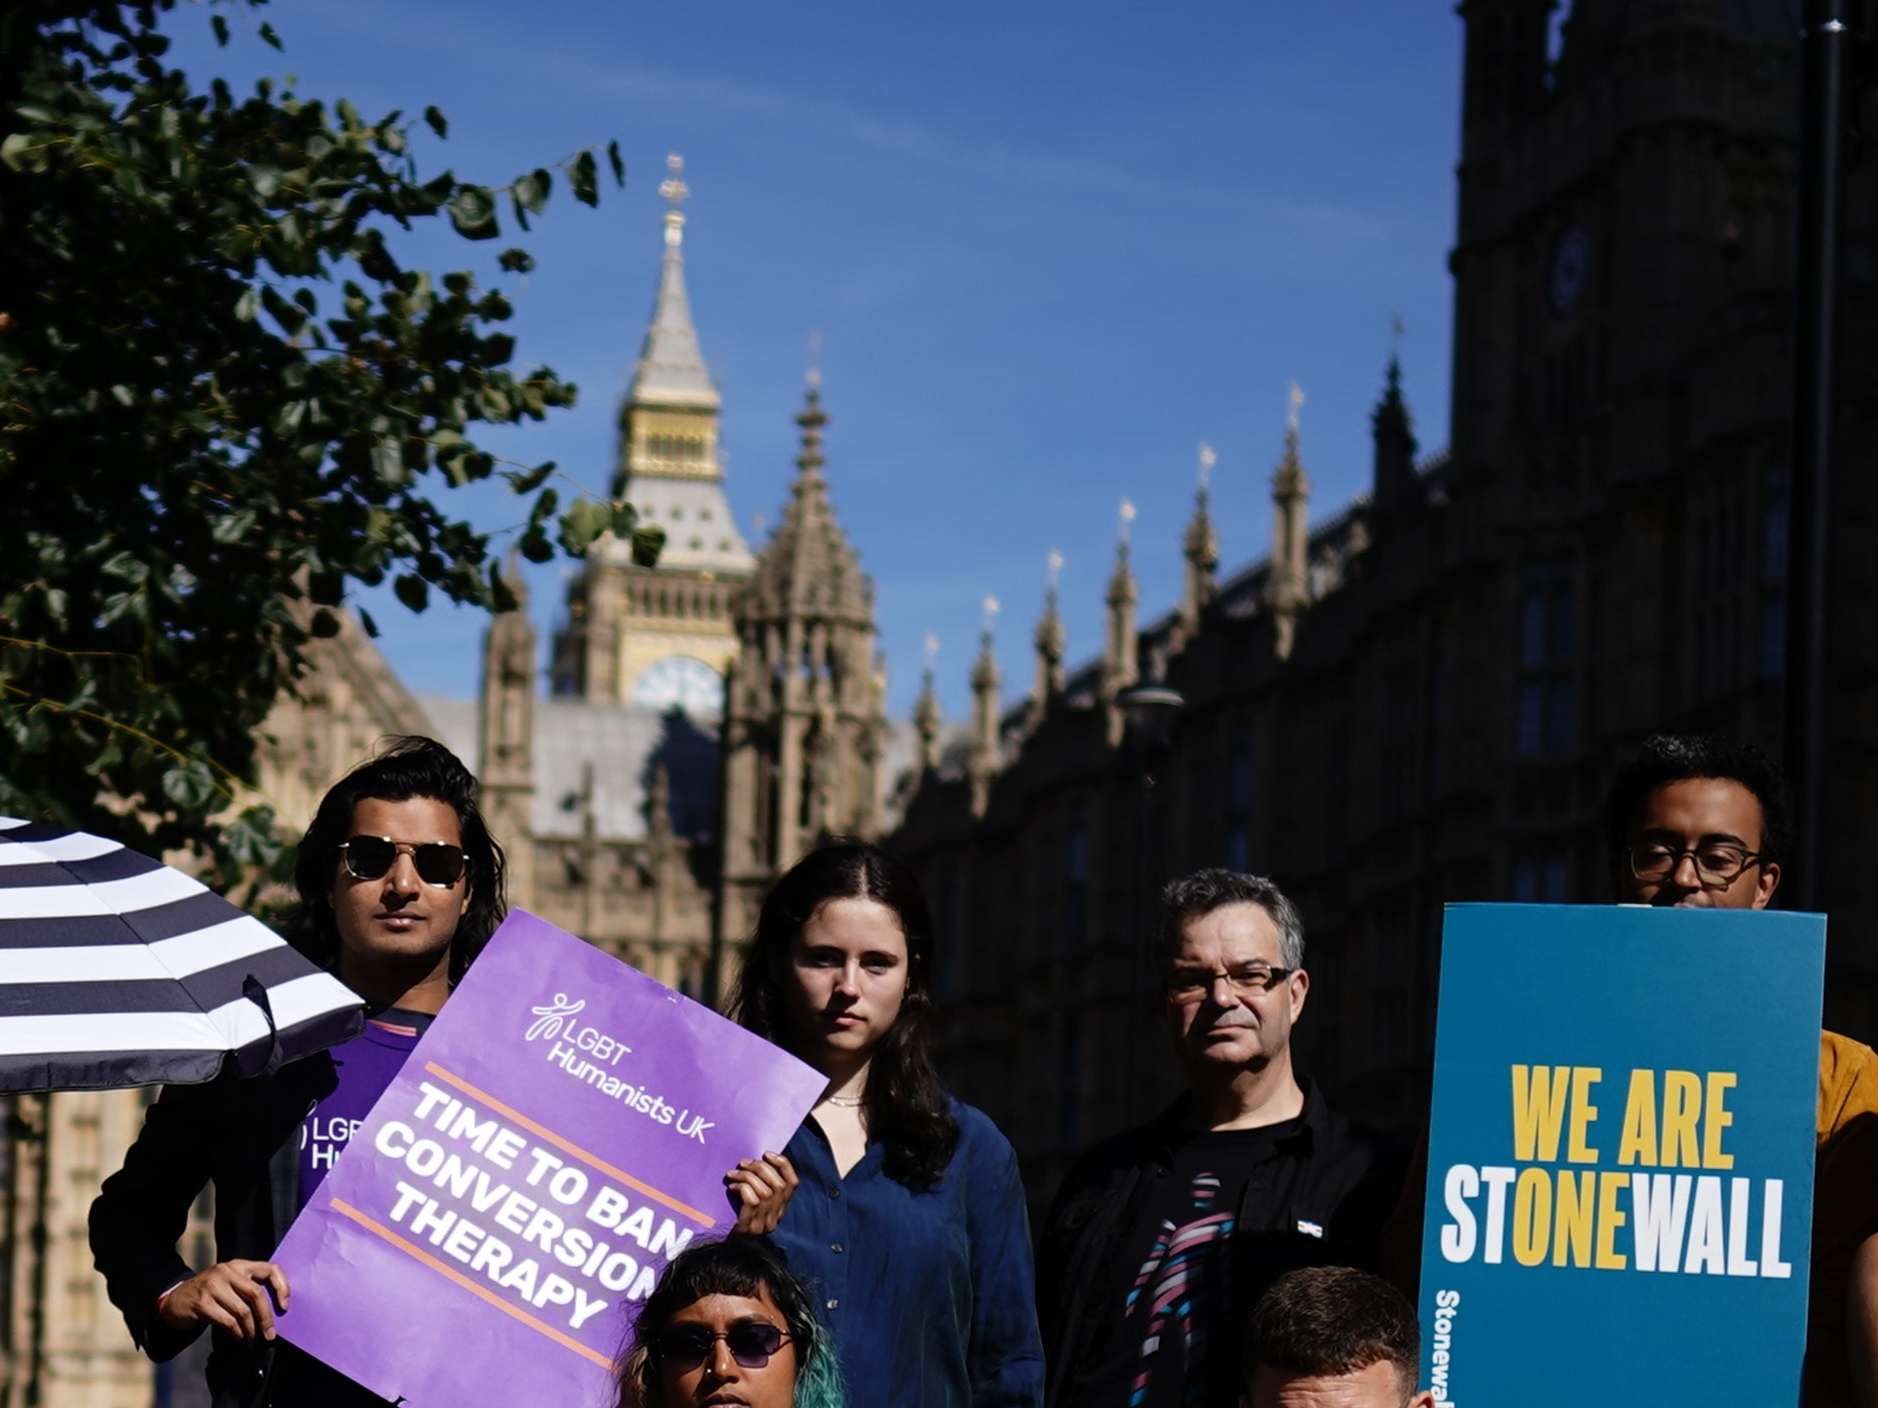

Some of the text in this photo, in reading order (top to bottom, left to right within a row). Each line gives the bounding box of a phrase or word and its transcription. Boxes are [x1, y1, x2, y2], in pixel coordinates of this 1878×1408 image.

[547, 1041, 716, 1144] Humanists UK
[562, 1020, 631, 1067] LGBT
[414, 1082, 695, 1261] TIME TO BAN
[1512, 1064, 1738, 1170] WE ARE
[375, 1120, 658, 1302] CONVERSION
[389, 1181, 608, 1330] THERAPY
[1440, 1164, 1792, 1279] STONEWALL
